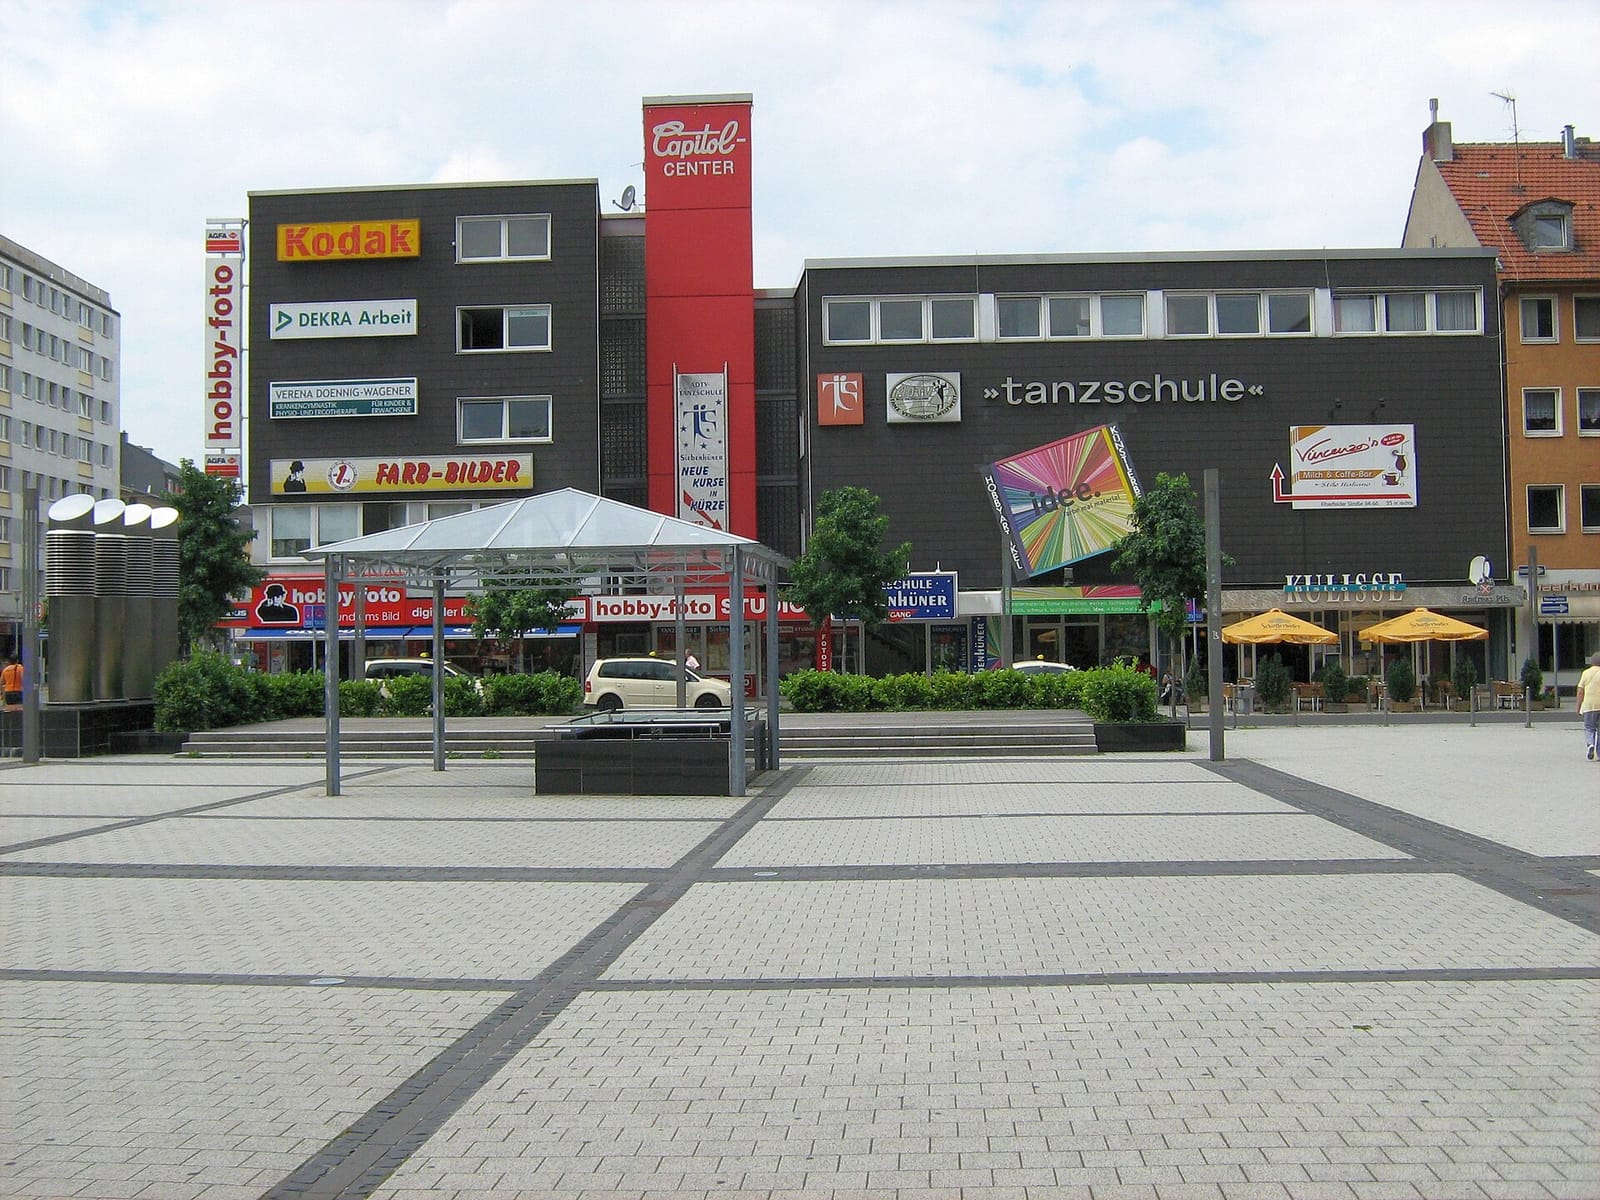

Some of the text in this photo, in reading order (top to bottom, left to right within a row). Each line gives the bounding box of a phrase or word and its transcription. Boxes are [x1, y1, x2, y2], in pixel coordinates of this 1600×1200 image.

[664, 160, 734, 176] CENTER
[285, 224, 412, 257] Kodak
[299, 309, 412, 327] DEKRA Arbeit
[207, 264, 238, 440] hobby-foto
[275, 386, 411, 399] VERENA DOENNIG-WAGENER
[275, 402, 337, 410] KRANKENGYMNASTIK
[1296, 437, 1379, 464] Vincenzo's
[375, 460, 521, 486] FARB-BILDER
[681, 467, 709, 476] NEUE
[1303, 470, 1323, 478] Milch
[692, 478, 725, 488] KURSE
[690, 499, 725, 511] KÜRZE
[1030, 482, 1101, 515] idee.
[1285, 573, 1403, 603] KULISSE
[1538, 582, 1599, 591] aarkun
[382, 611, 400, 621] Bild
[411, 608, 457, 619] digiler
